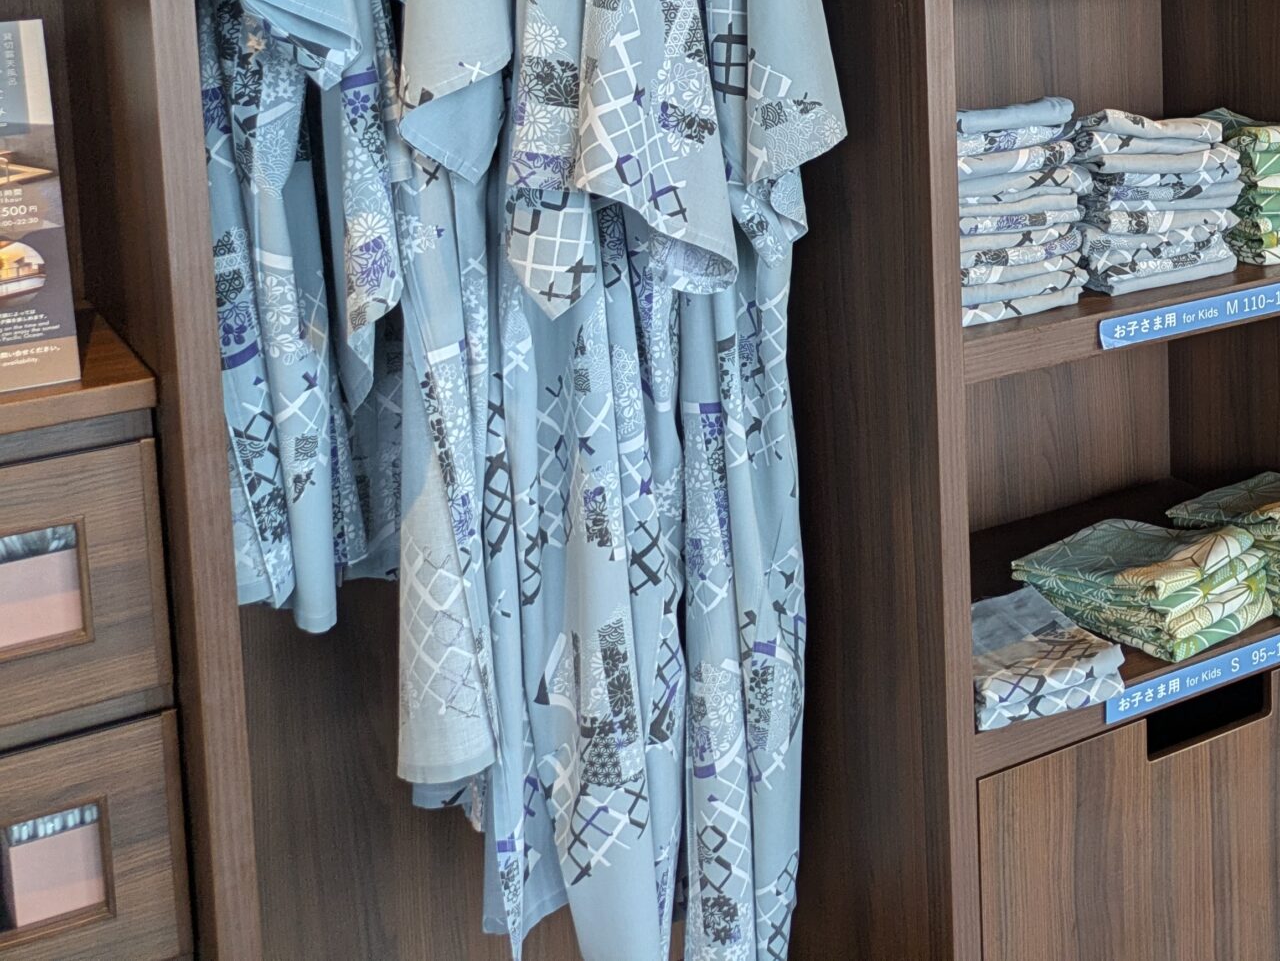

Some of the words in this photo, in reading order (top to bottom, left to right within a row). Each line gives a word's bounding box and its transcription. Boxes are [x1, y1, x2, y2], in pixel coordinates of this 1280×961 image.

[1114, 312, 1177, 339] お子さま用
[1183, 312, 1195, 324] for
[1198, 307, 1219, 320] Kids
[1226, 300, 1239, 315] M
[1117, 677, 1181, 713] お子さま用
[1186, 676, 1199, 689] for
[1202, 667, 1222, 682] Kids
[1231, 657, 1240, 673] S
